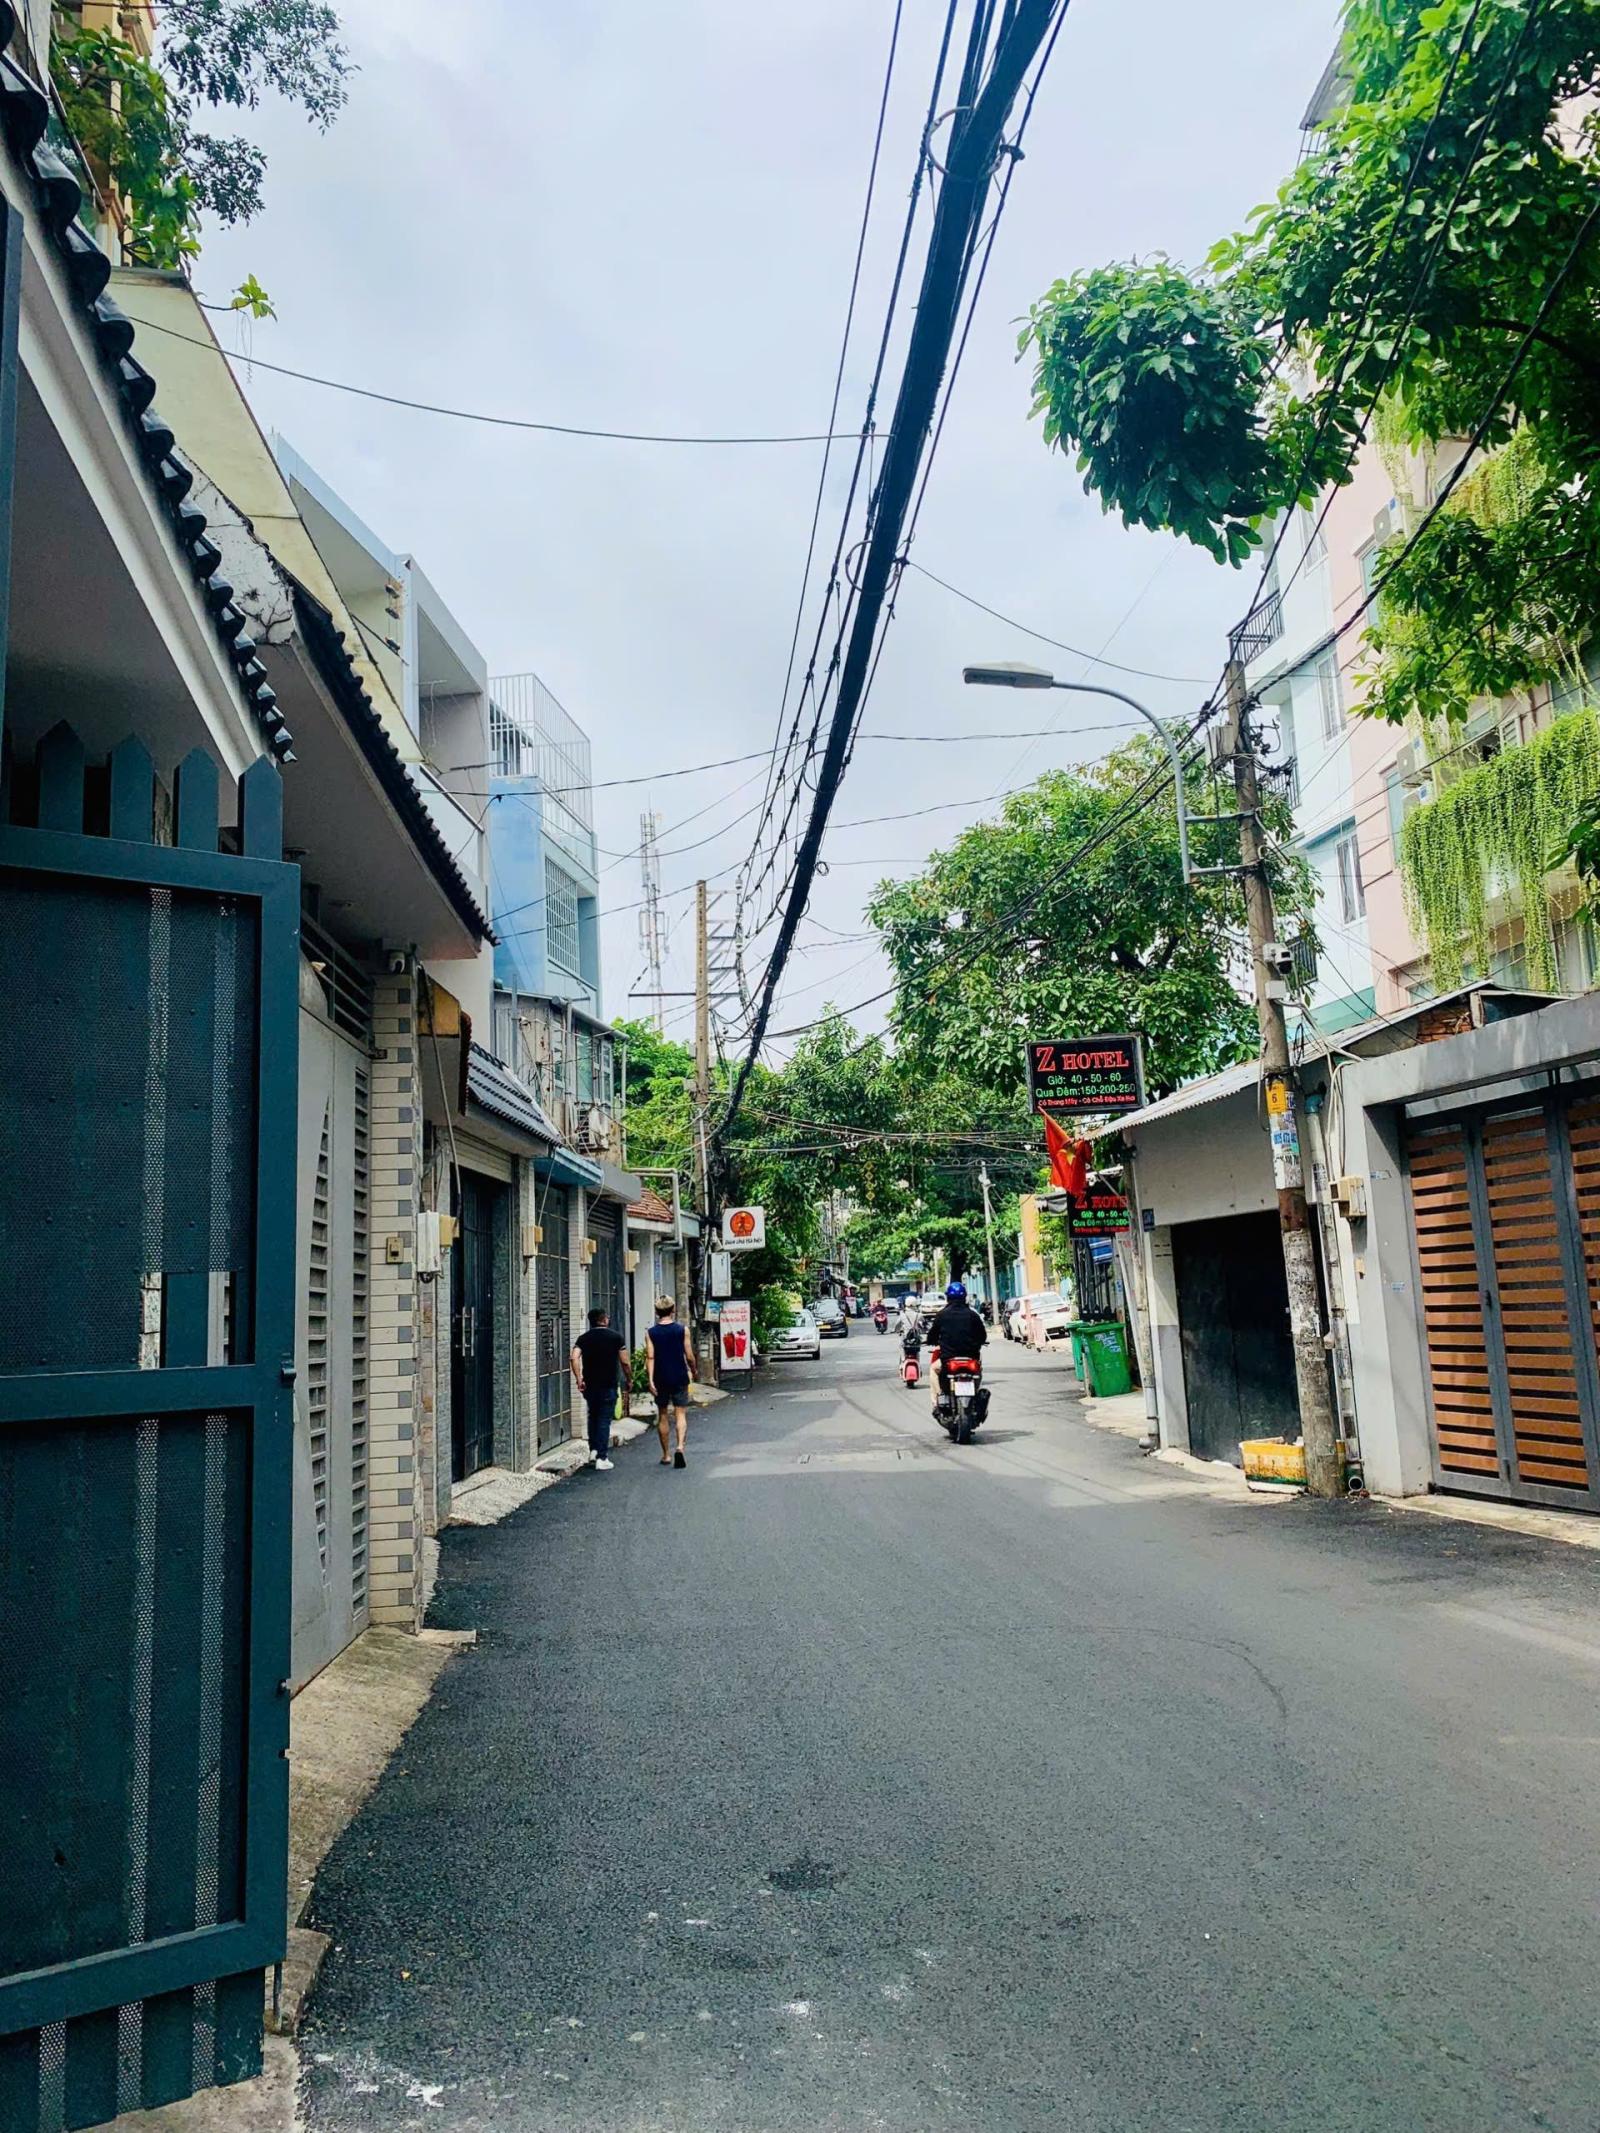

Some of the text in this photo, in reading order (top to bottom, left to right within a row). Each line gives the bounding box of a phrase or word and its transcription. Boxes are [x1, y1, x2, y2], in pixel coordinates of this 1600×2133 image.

[1036, 1046, 1130, 1072] Z HOTEL
[1070, 1074, 1083, 1084] 40
[1090, 1073, 1102, 1083] 50
[1109, 1072, 1122, 1082] 60
[1035, 1088, 1054, 1098] Qua
